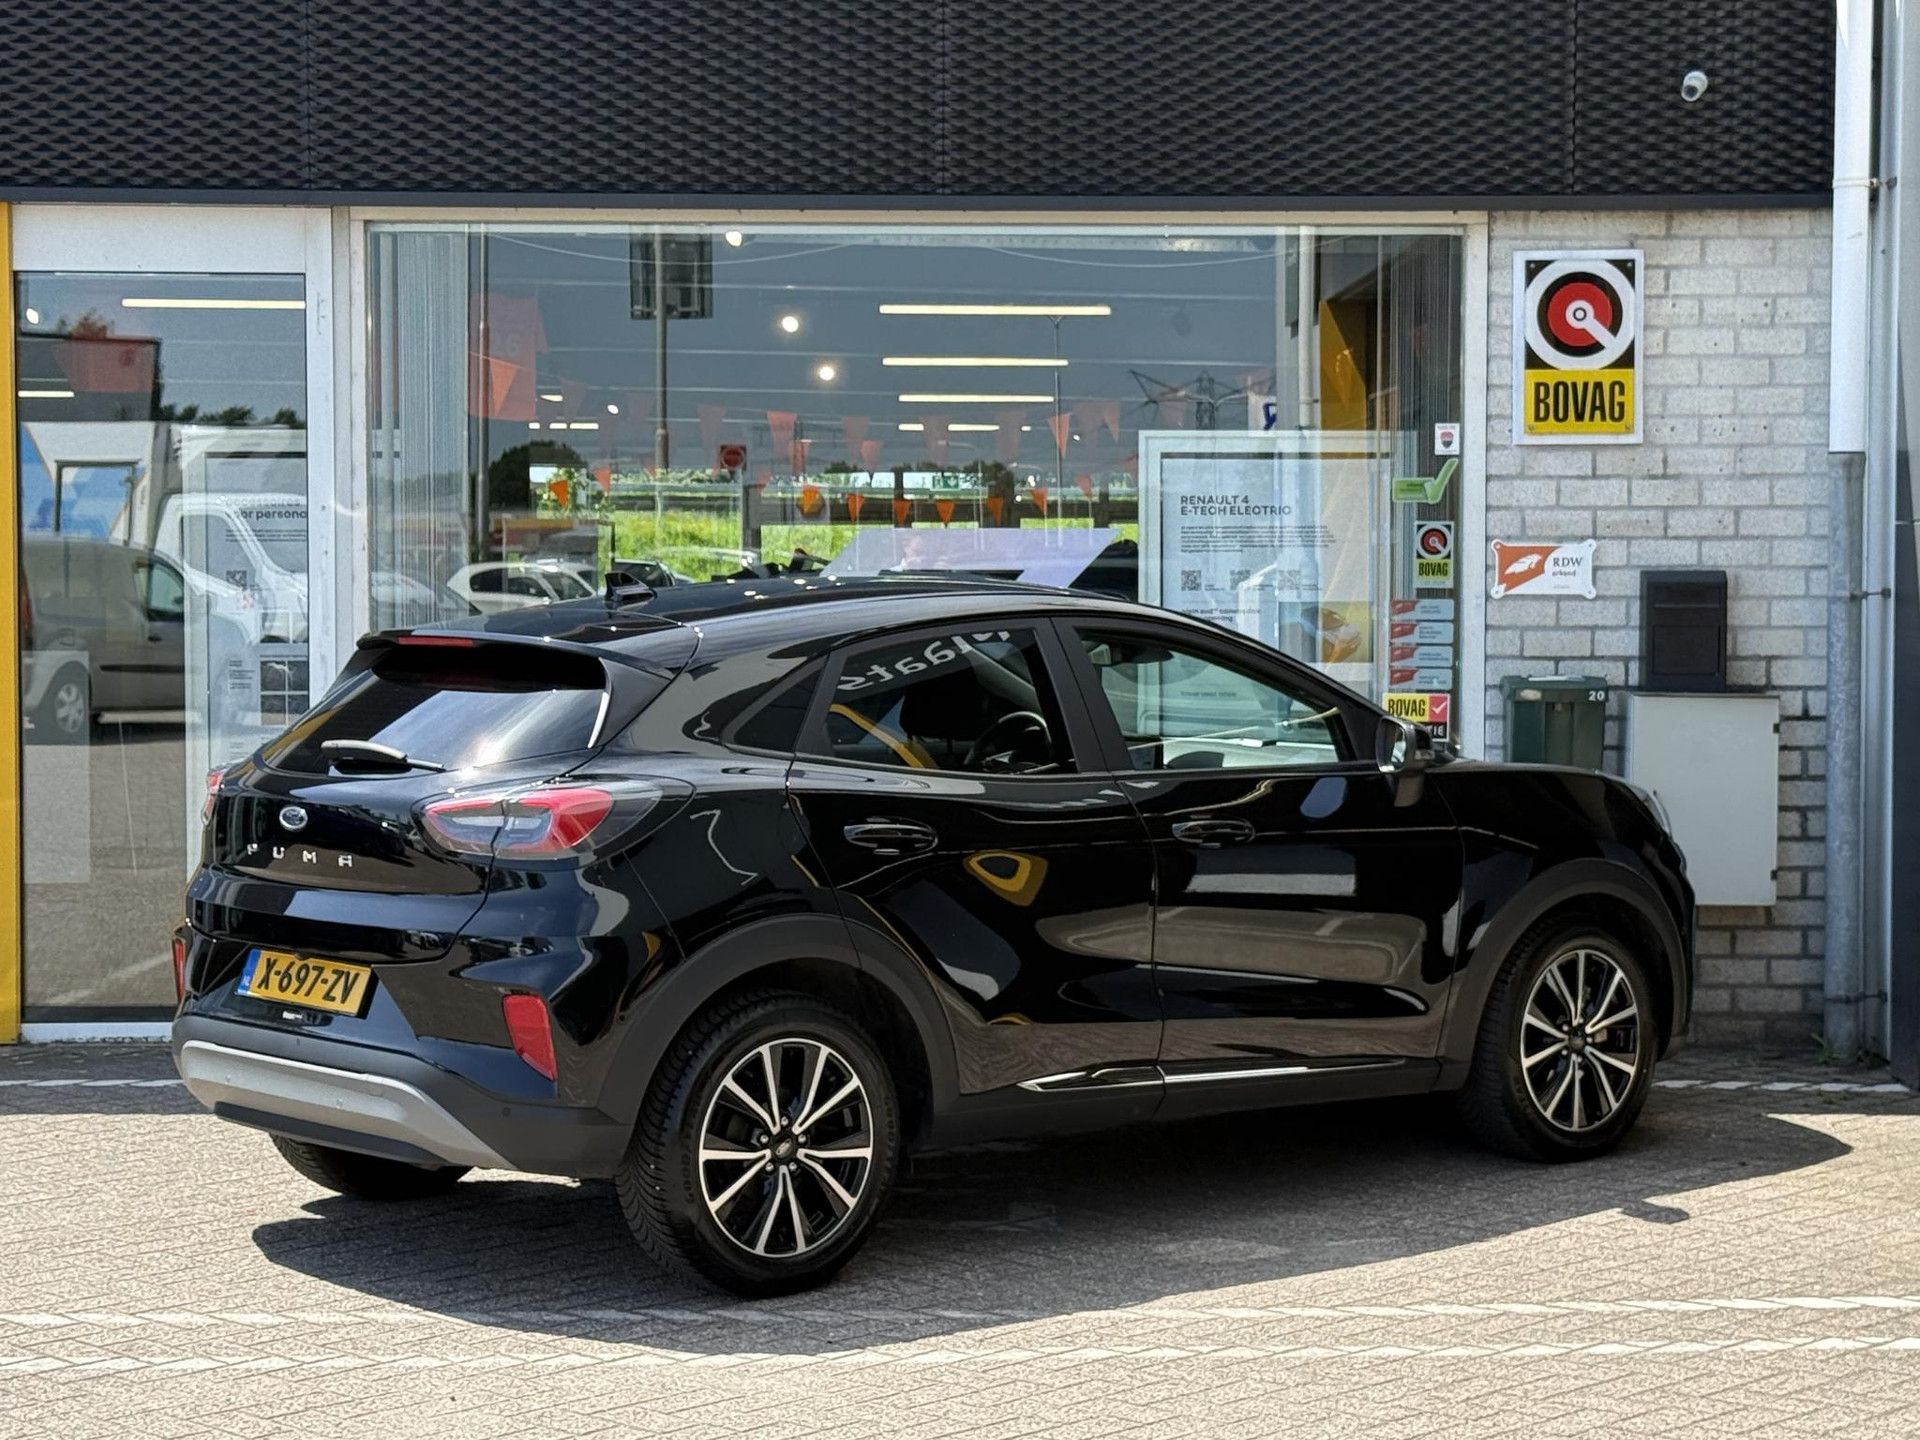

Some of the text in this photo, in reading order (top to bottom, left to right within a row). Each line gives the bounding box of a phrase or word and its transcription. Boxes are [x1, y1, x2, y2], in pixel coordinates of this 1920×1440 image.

[1534, 381, 1625, 423] BOVAG
[1181, 495, 1249, 505] RENAULT 4
[1181, 505, 1292, 515] E-TECH ELECTRIC
[1418, 562, 1448, 576] BOVAG
[1553, 557, 1583, 567] RDW
[1588, 690, 1605, 701] 20
[1388, 699, 1426, 717] BOVAG
[247, 843, 353, 868] PUMA
[257, 957, 360, 1004] X-697-ZV
